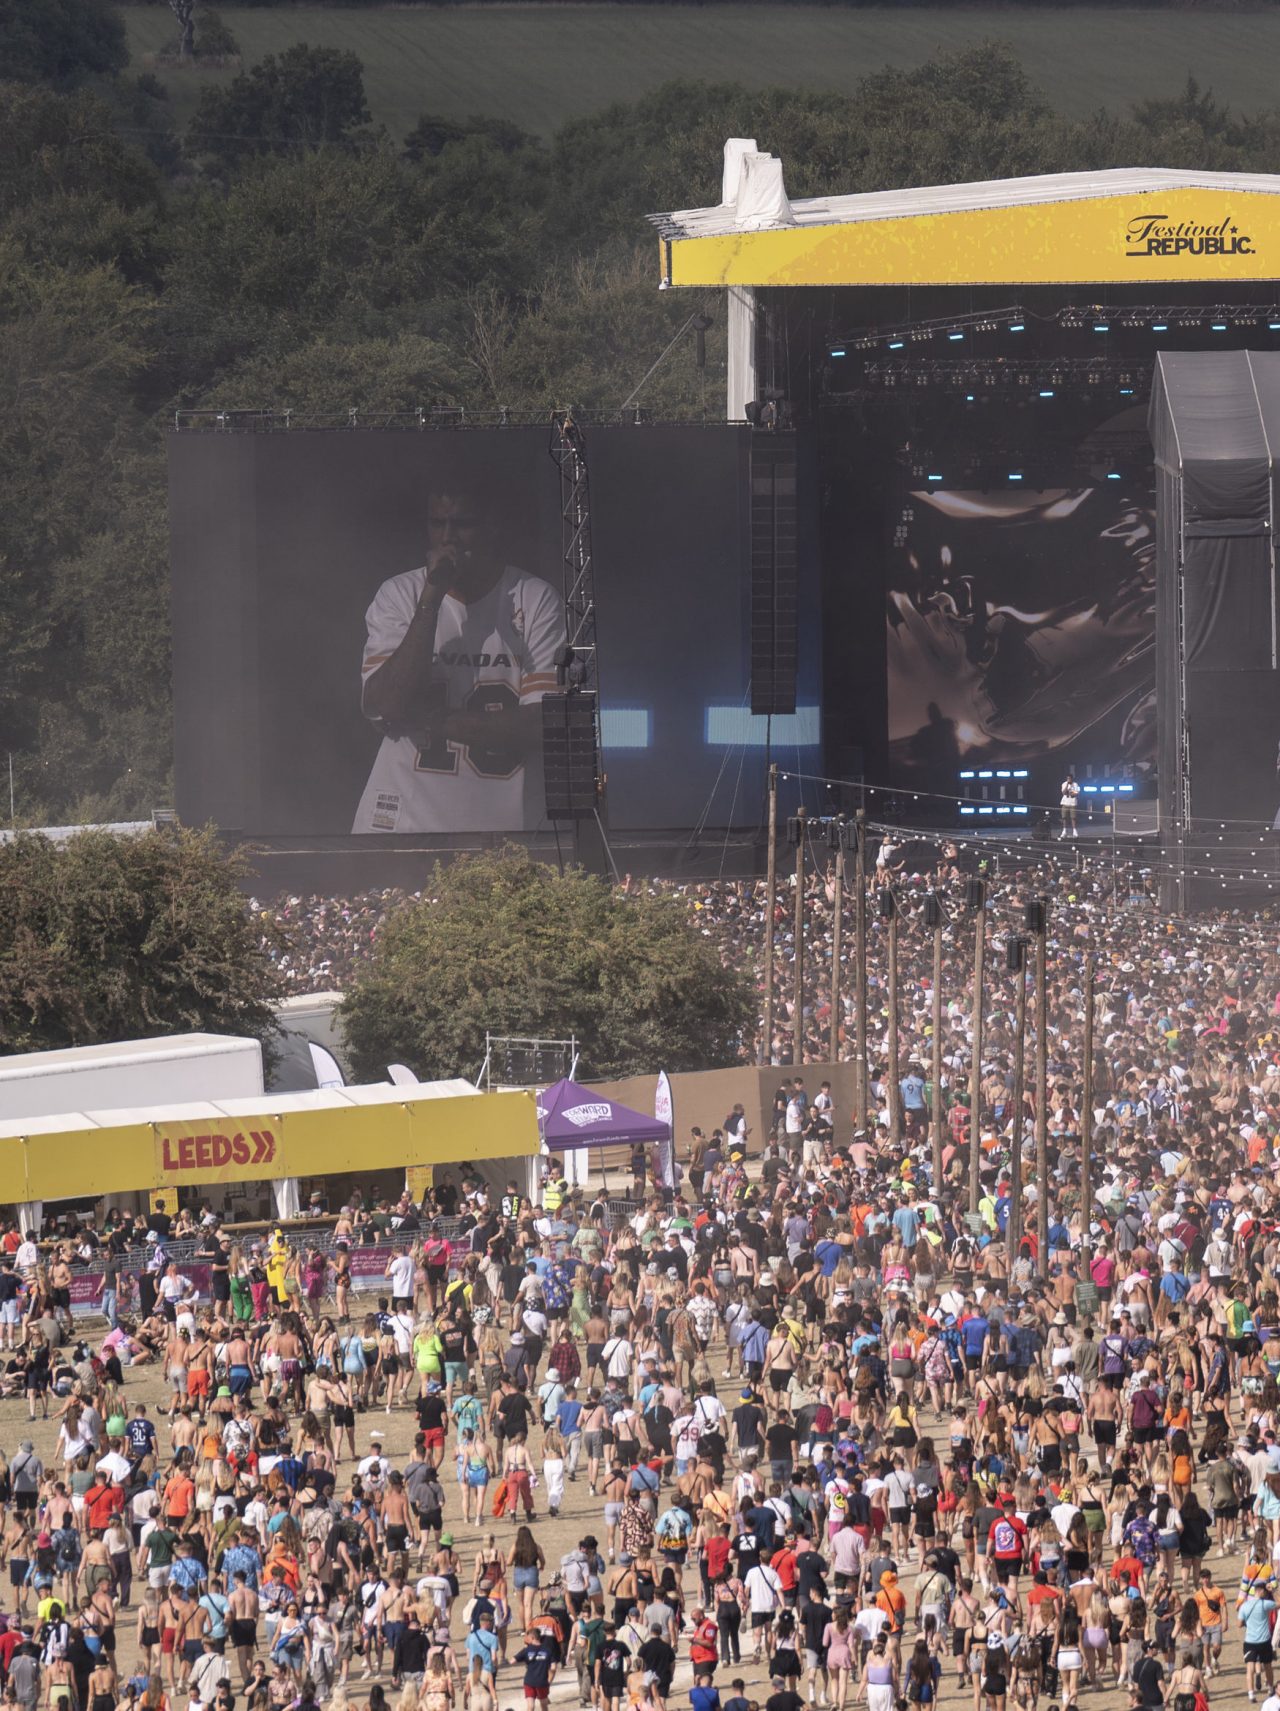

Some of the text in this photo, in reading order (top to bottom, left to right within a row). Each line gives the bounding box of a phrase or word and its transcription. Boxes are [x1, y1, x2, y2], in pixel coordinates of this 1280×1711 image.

[1126, 215, 1231, 243] Festival
[907, 1084, 914, 1095] 9
[163, 1133, 250, 1170] LEEDS
[1003, 1205, 1009, 1217] 5
